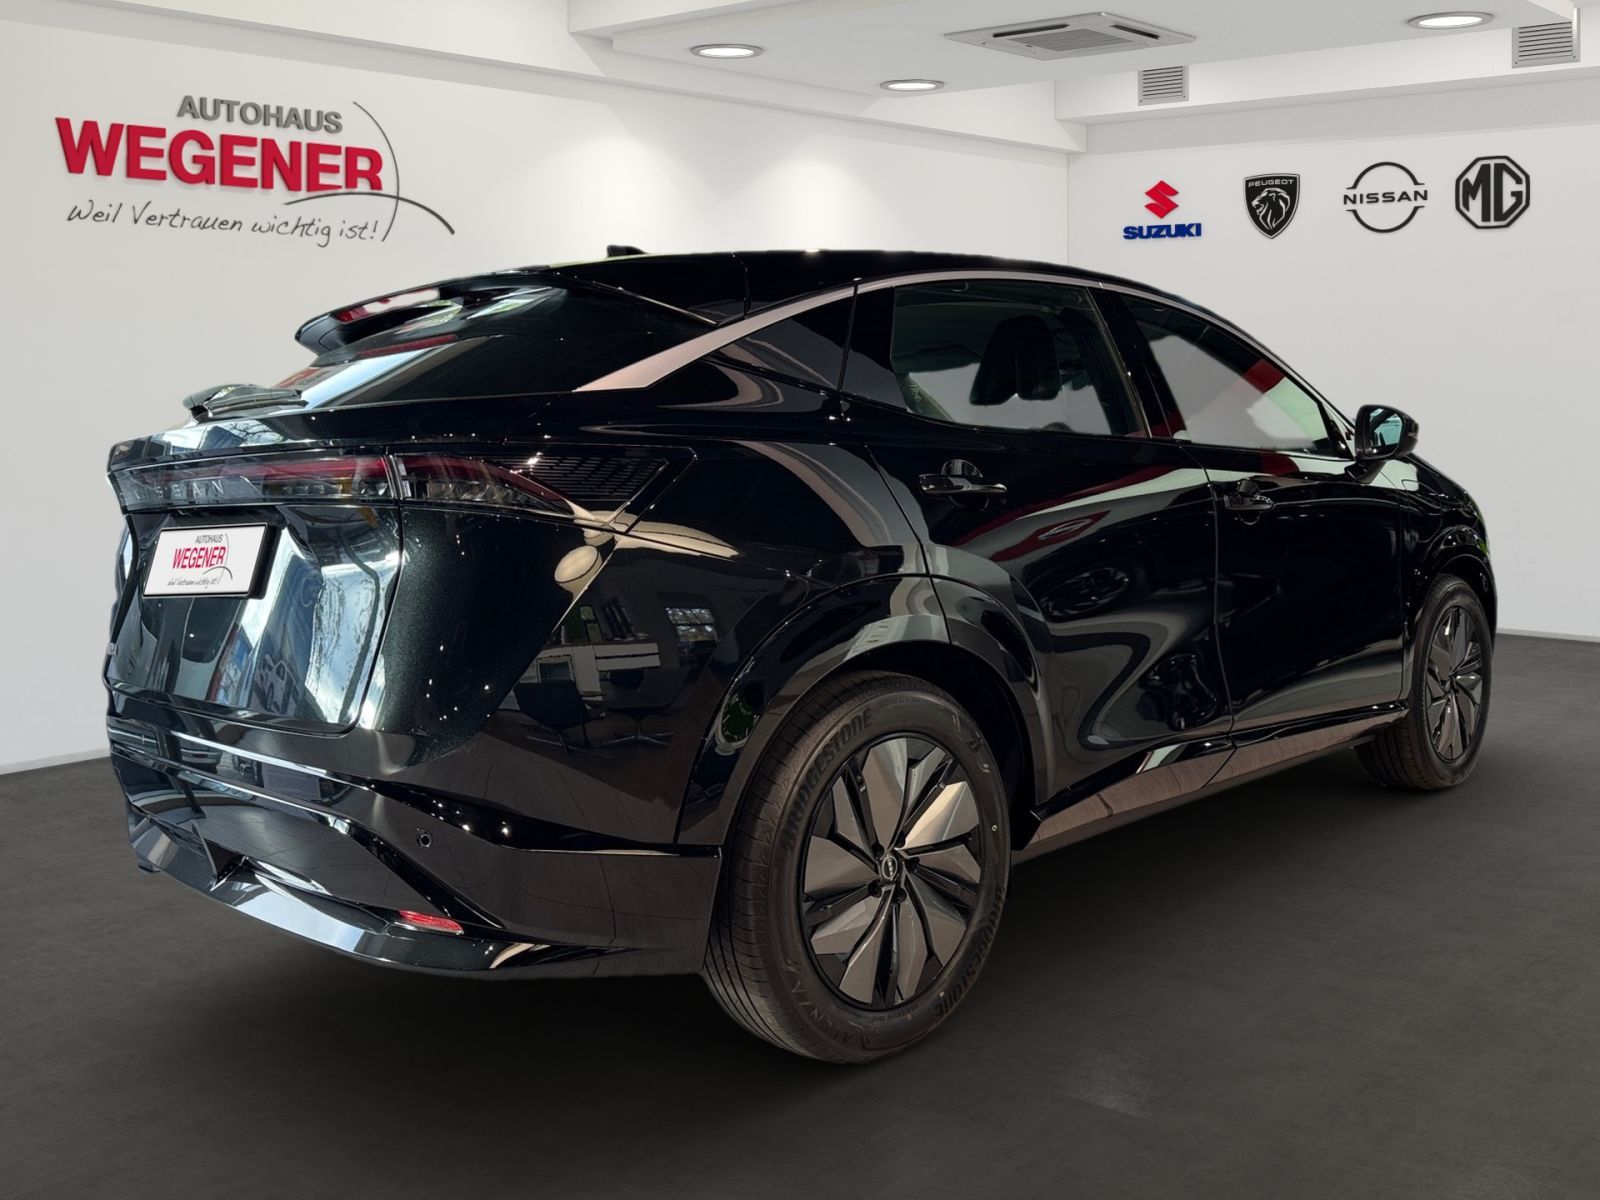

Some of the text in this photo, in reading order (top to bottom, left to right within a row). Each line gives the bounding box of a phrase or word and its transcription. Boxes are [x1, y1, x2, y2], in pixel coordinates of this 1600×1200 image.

[177, 95, 343, 134] AUTOHAUS
[55, 117, 384, 193] WEGENER
[1248, 179, 1295, 188] PEUGEOT
[1343, 189, 1429, 206] NISSAN
[1462, 163, 1524, 223] MG
[66, 199, 379, 248] Weil Vertrauen wichtig ist!
[1122, 222, 1203, 240] SUZUKI
[194, 534, 224, 545] AUTOHAUS
[172, 546, 226, 570] WEGENER
[780, 707, 874, 855] BRIDGESTONE
